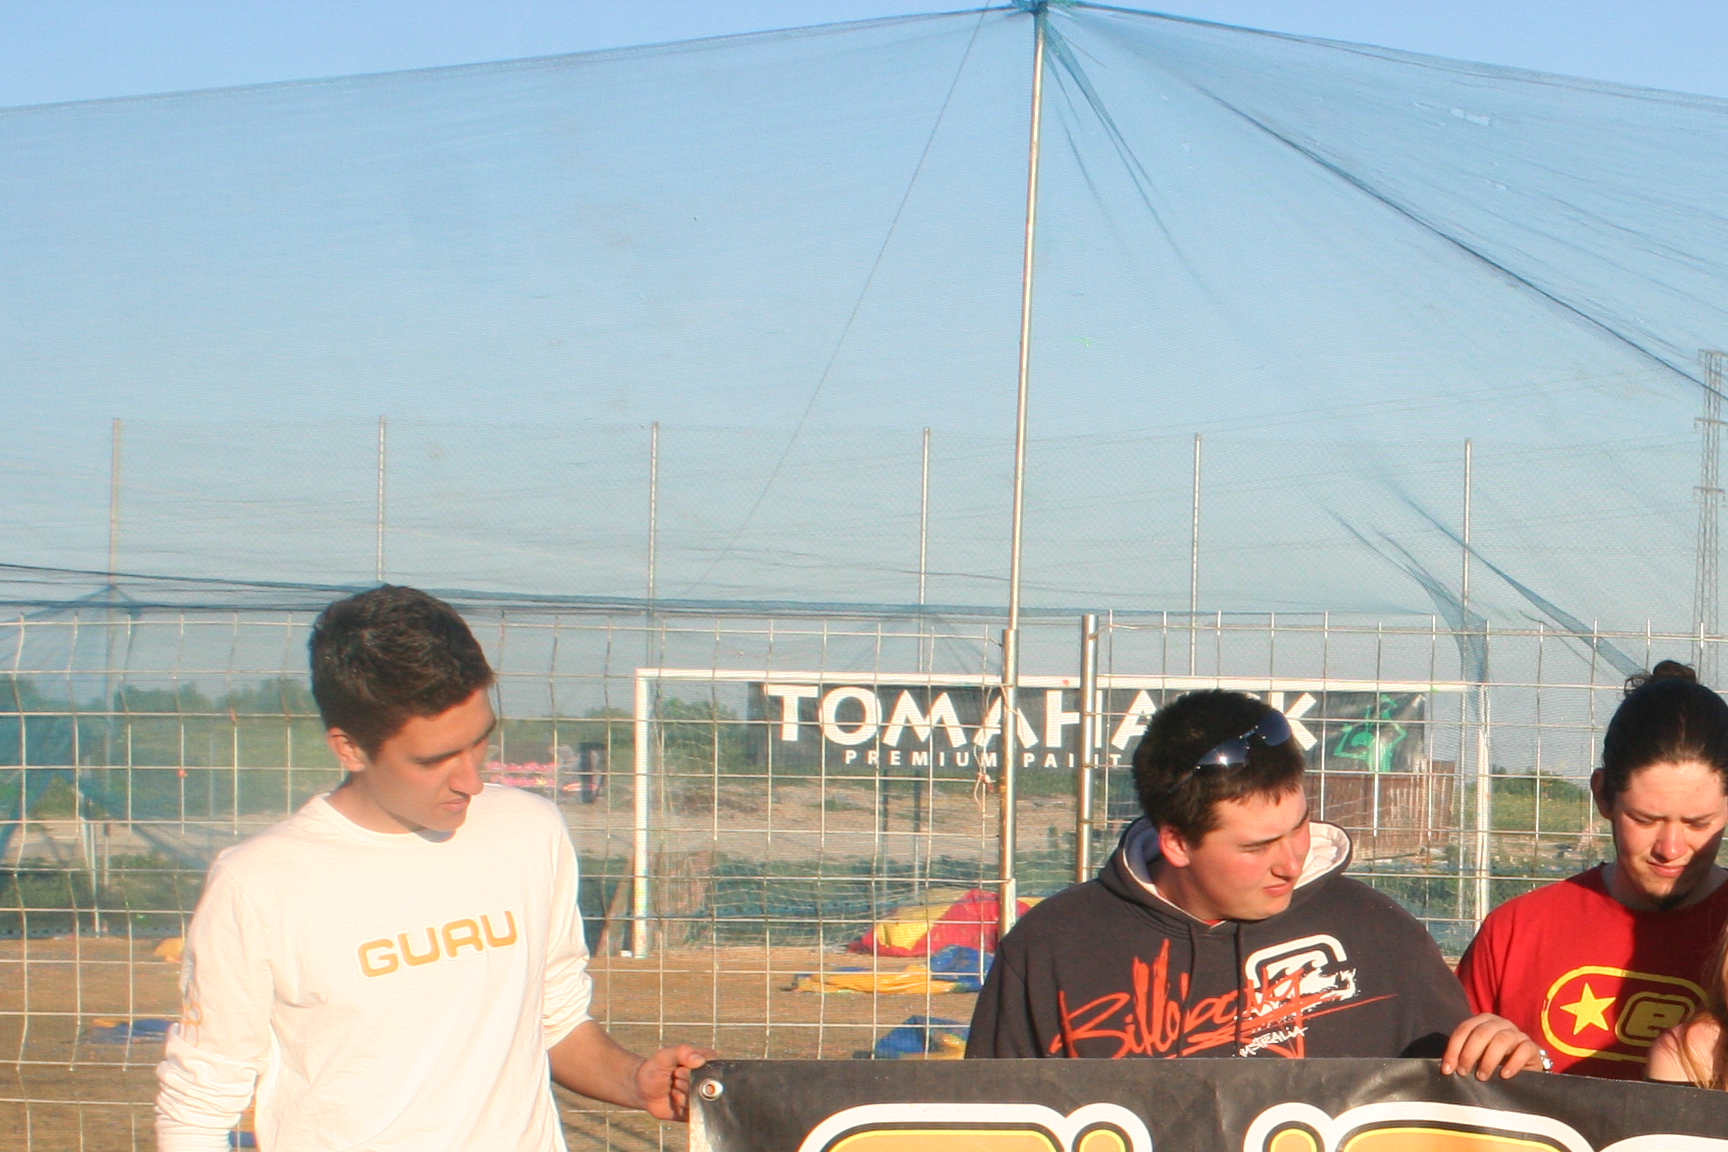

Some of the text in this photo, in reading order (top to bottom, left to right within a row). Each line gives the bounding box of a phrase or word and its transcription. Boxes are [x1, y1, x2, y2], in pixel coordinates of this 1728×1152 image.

[763, 685, 1318, 751] TOMAHAK
[845, 749, 998, 768] PREMIUM
[357, 910, 517, 978] GURU
